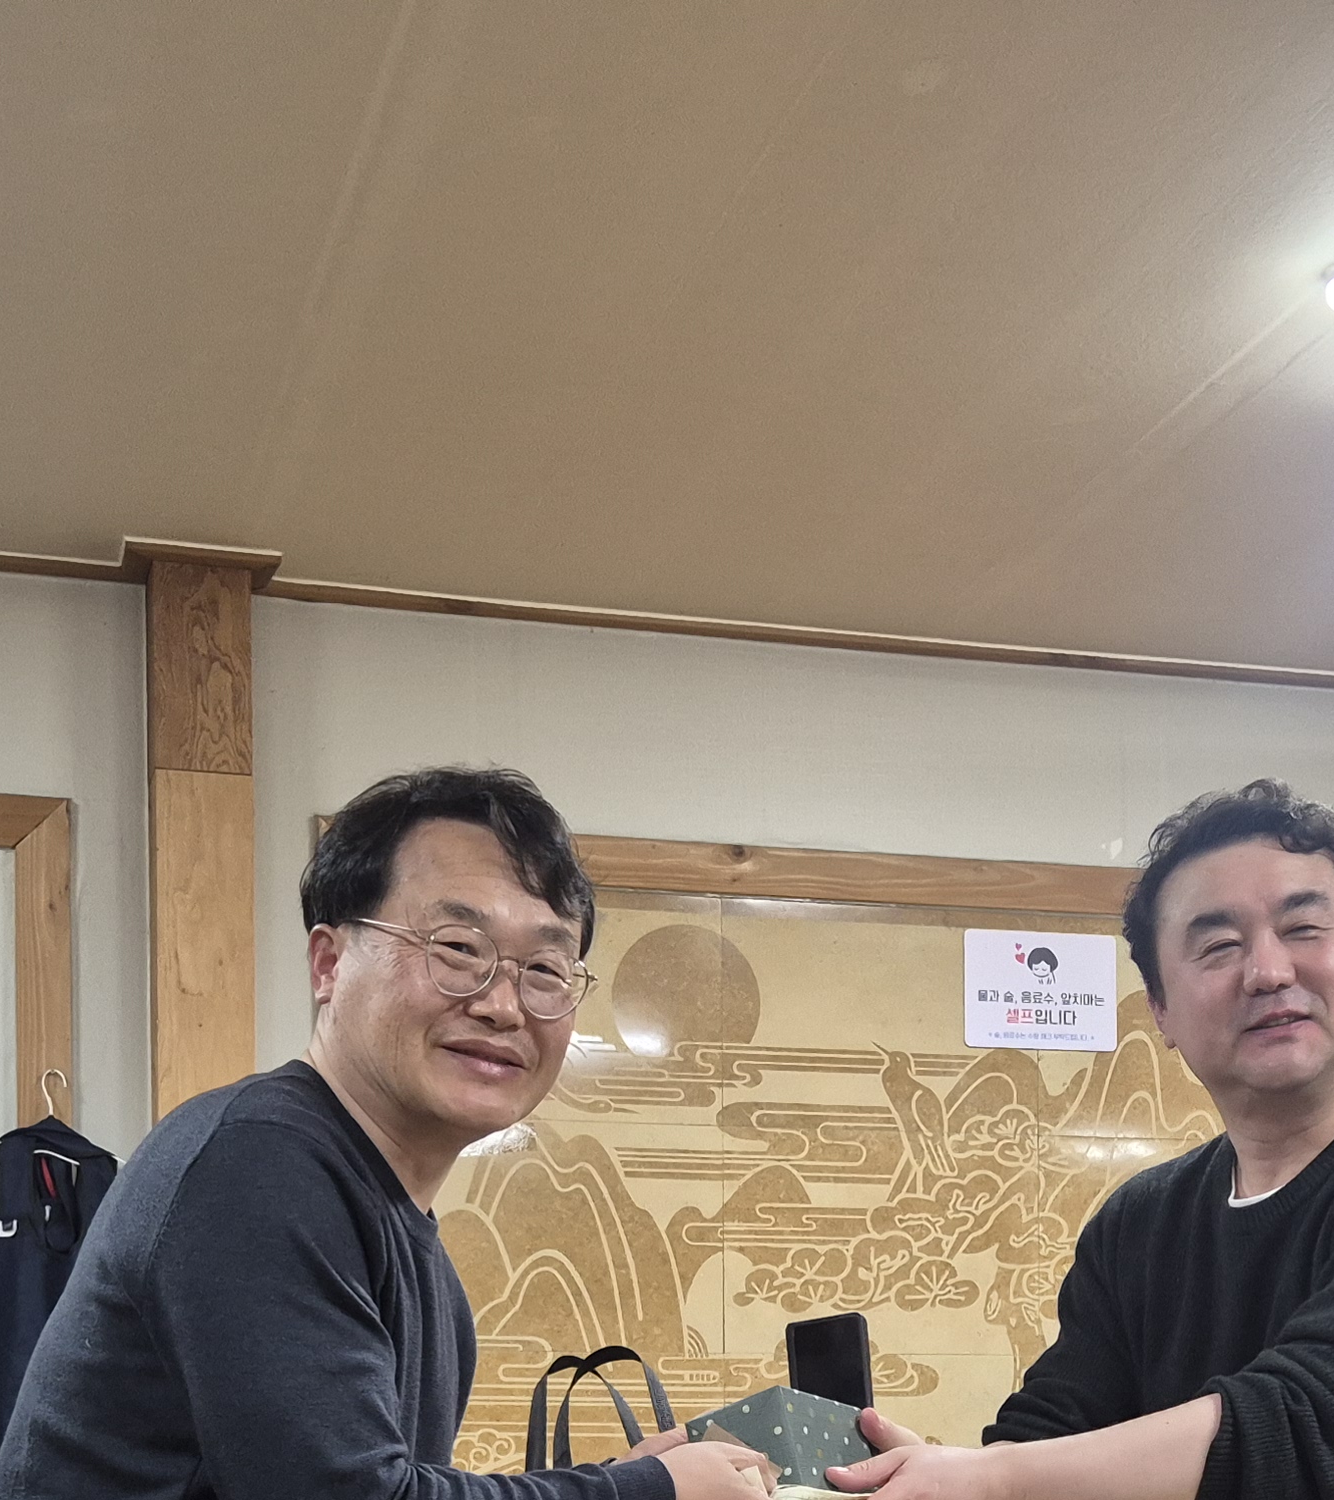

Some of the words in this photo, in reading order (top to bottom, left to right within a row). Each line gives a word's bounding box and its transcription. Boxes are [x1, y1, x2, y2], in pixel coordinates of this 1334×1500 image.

[977, 989, 1000, 1003] 물과
[1060, 992, 1105, 1007] 앞치마는
[1005, 1008, 1078, 1026] 셀프입니다
